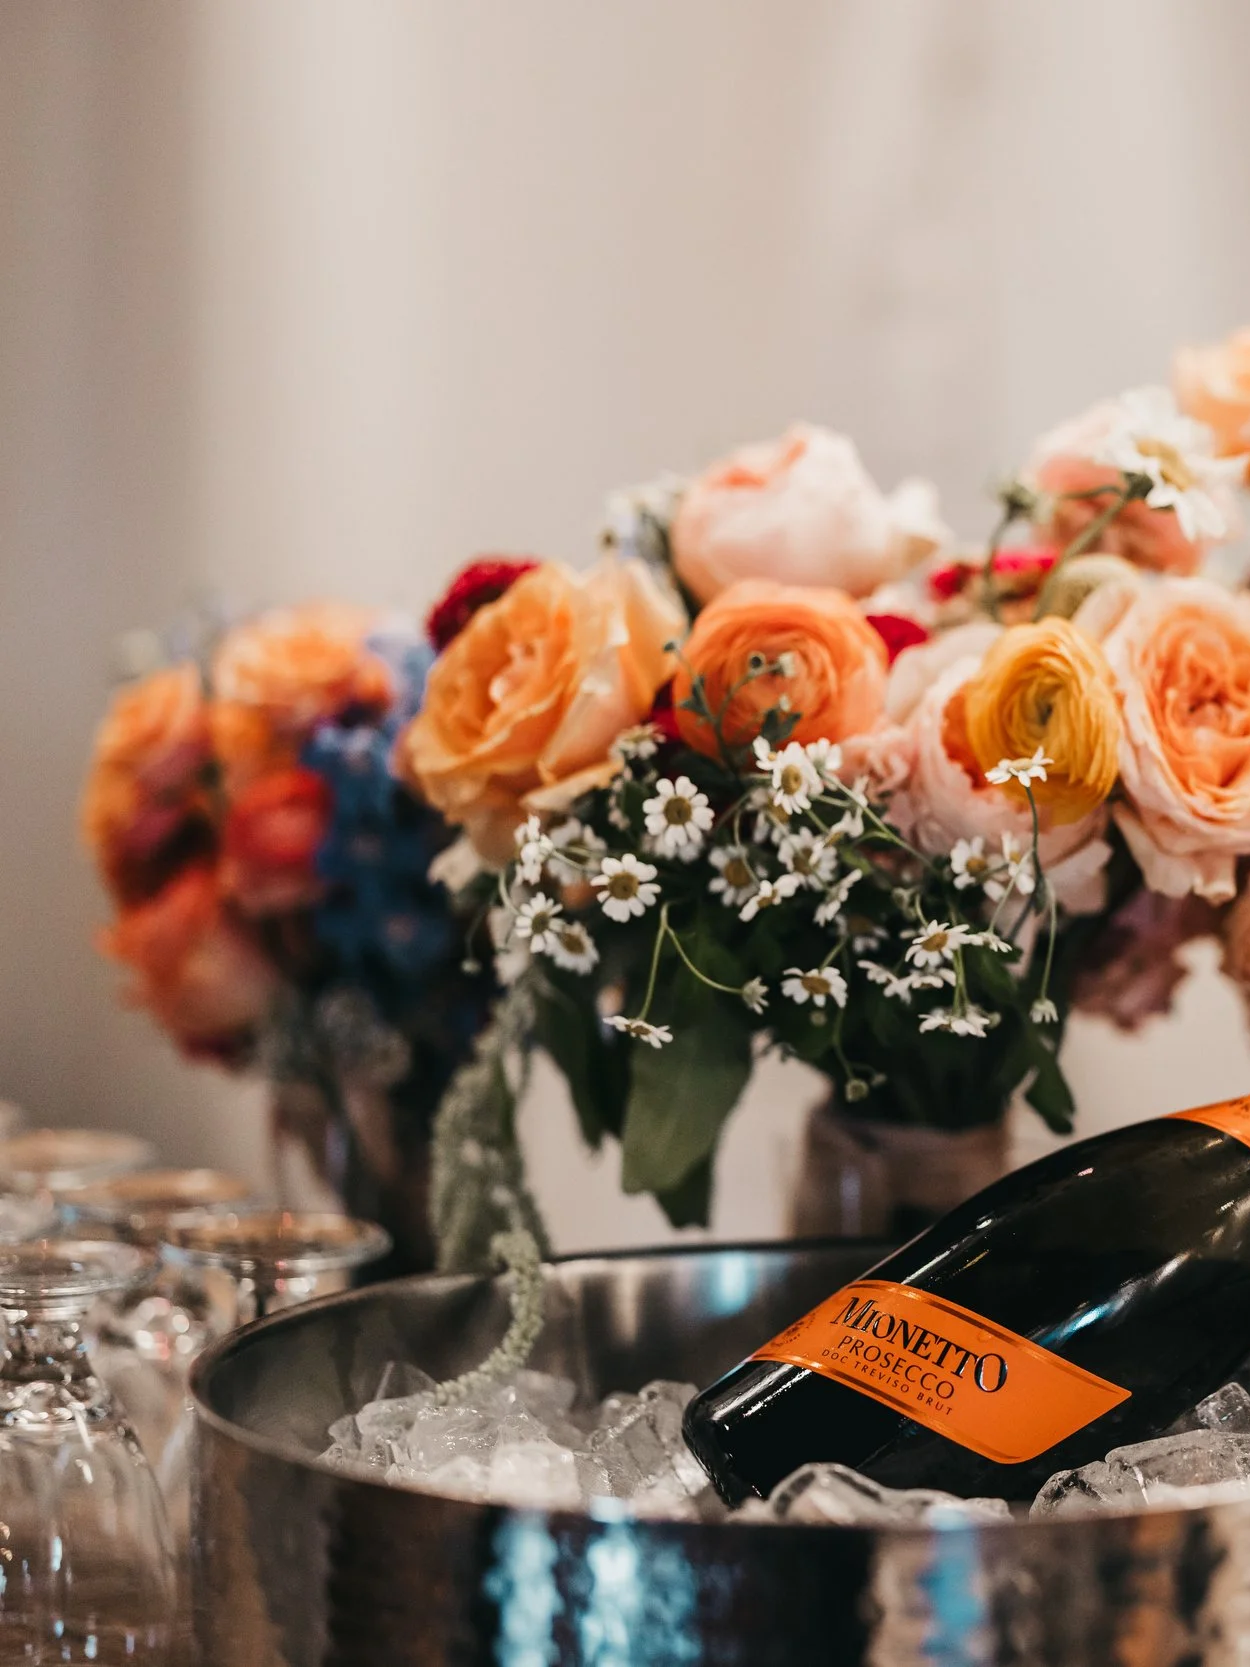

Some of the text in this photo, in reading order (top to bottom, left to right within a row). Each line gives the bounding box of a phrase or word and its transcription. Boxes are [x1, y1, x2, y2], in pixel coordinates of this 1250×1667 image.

[829, 1296, 1009, 1393] MIONETTO
[837, 1335, 955, 1400] PROSECCO
[821, 1349, 953, 1416] DOC TREVISO BRUT
